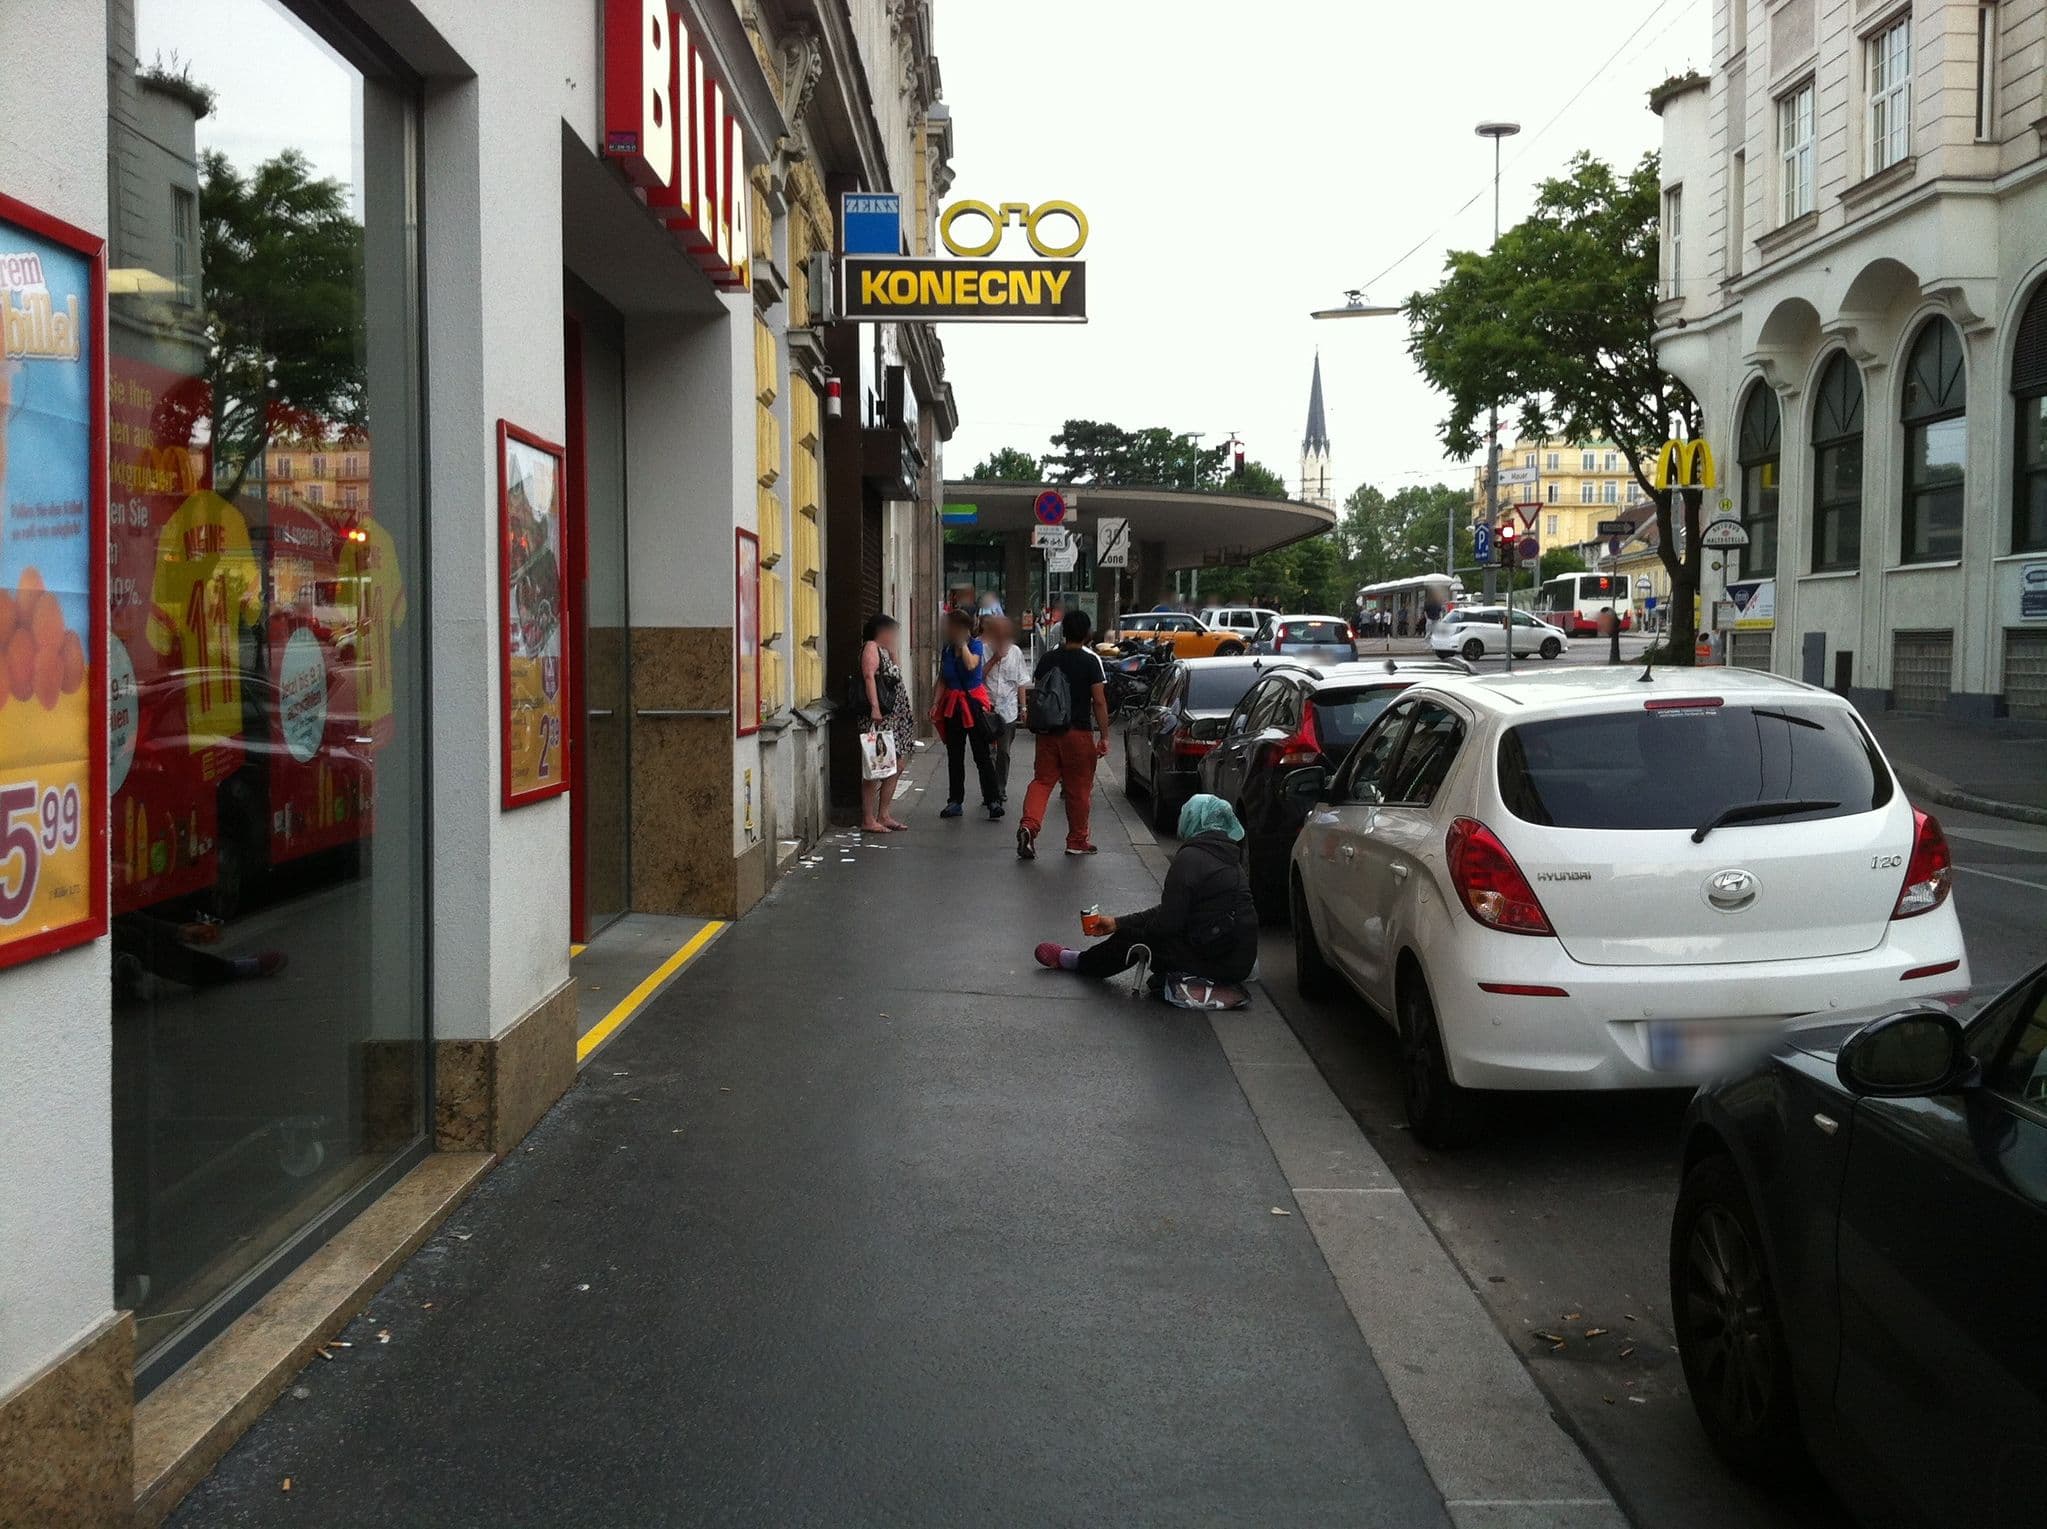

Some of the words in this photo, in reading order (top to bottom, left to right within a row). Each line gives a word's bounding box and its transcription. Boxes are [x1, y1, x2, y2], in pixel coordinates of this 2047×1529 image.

[643, 0, 749, 291] BILLA
[846, 199, 898, 214] ZEISS
[861, 269, 1072, 306] KONECNY
[1478, 531, 1486, 549] P
[1537, 871, 1592, 881] HYUNDAI
